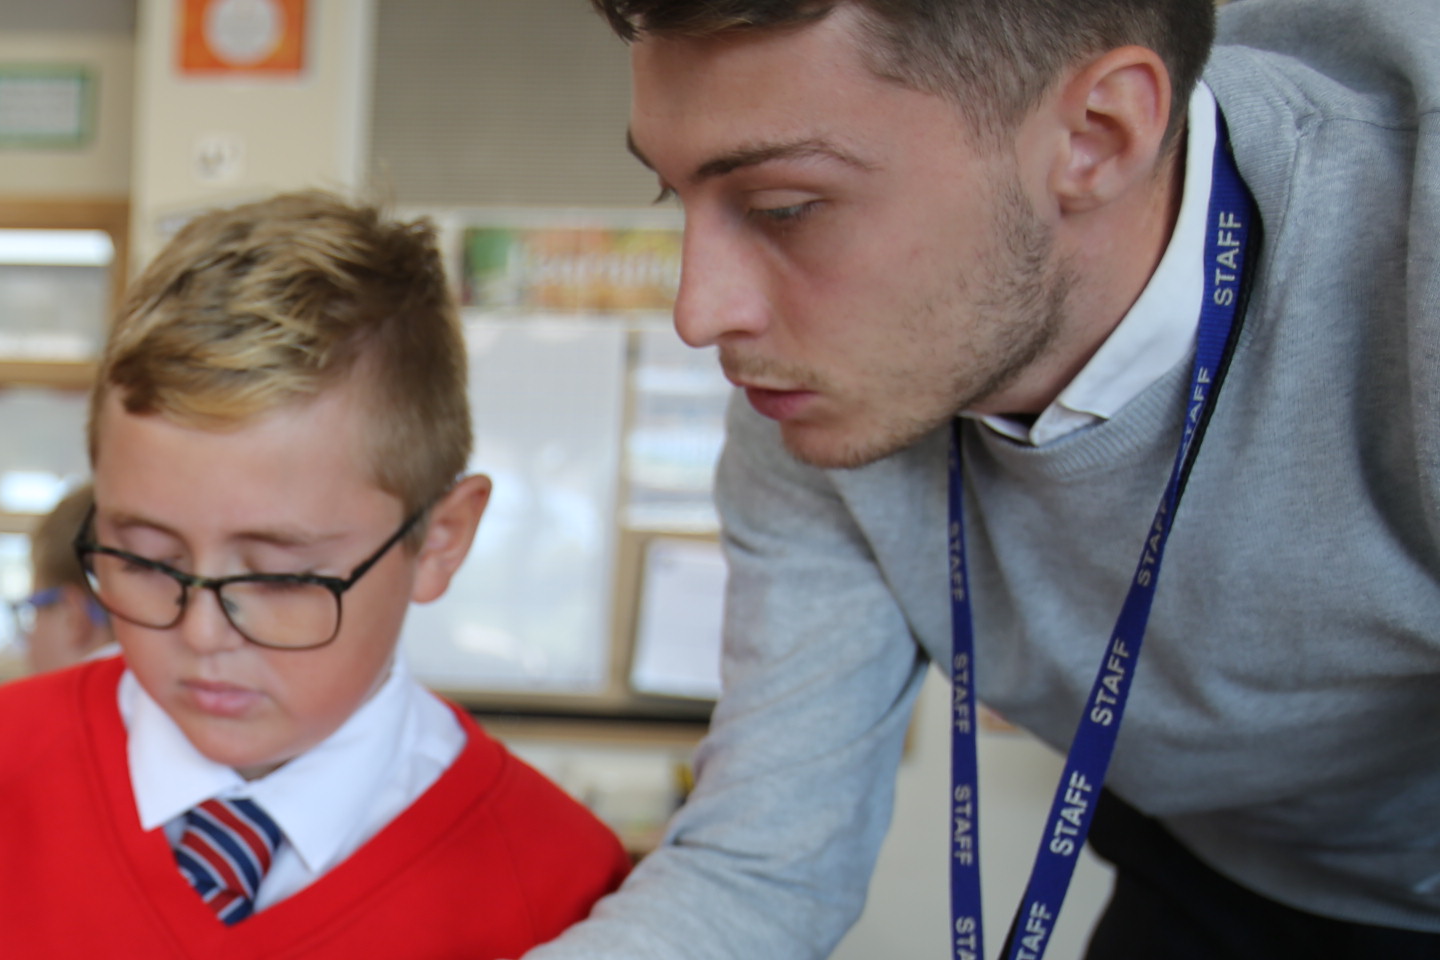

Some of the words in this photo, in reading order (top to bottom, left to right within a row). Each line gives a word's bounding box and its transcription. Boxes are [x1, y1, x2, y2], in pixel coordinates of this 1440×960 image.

[1214, 211, 1243, 306] STAFF
[953, 652, 971, 735] STAFF
[1090, 638, 1131, 727] STAFF
[954, 785, 973, 867] STAFF
[1049, 770, 1094, 857] STAFF
